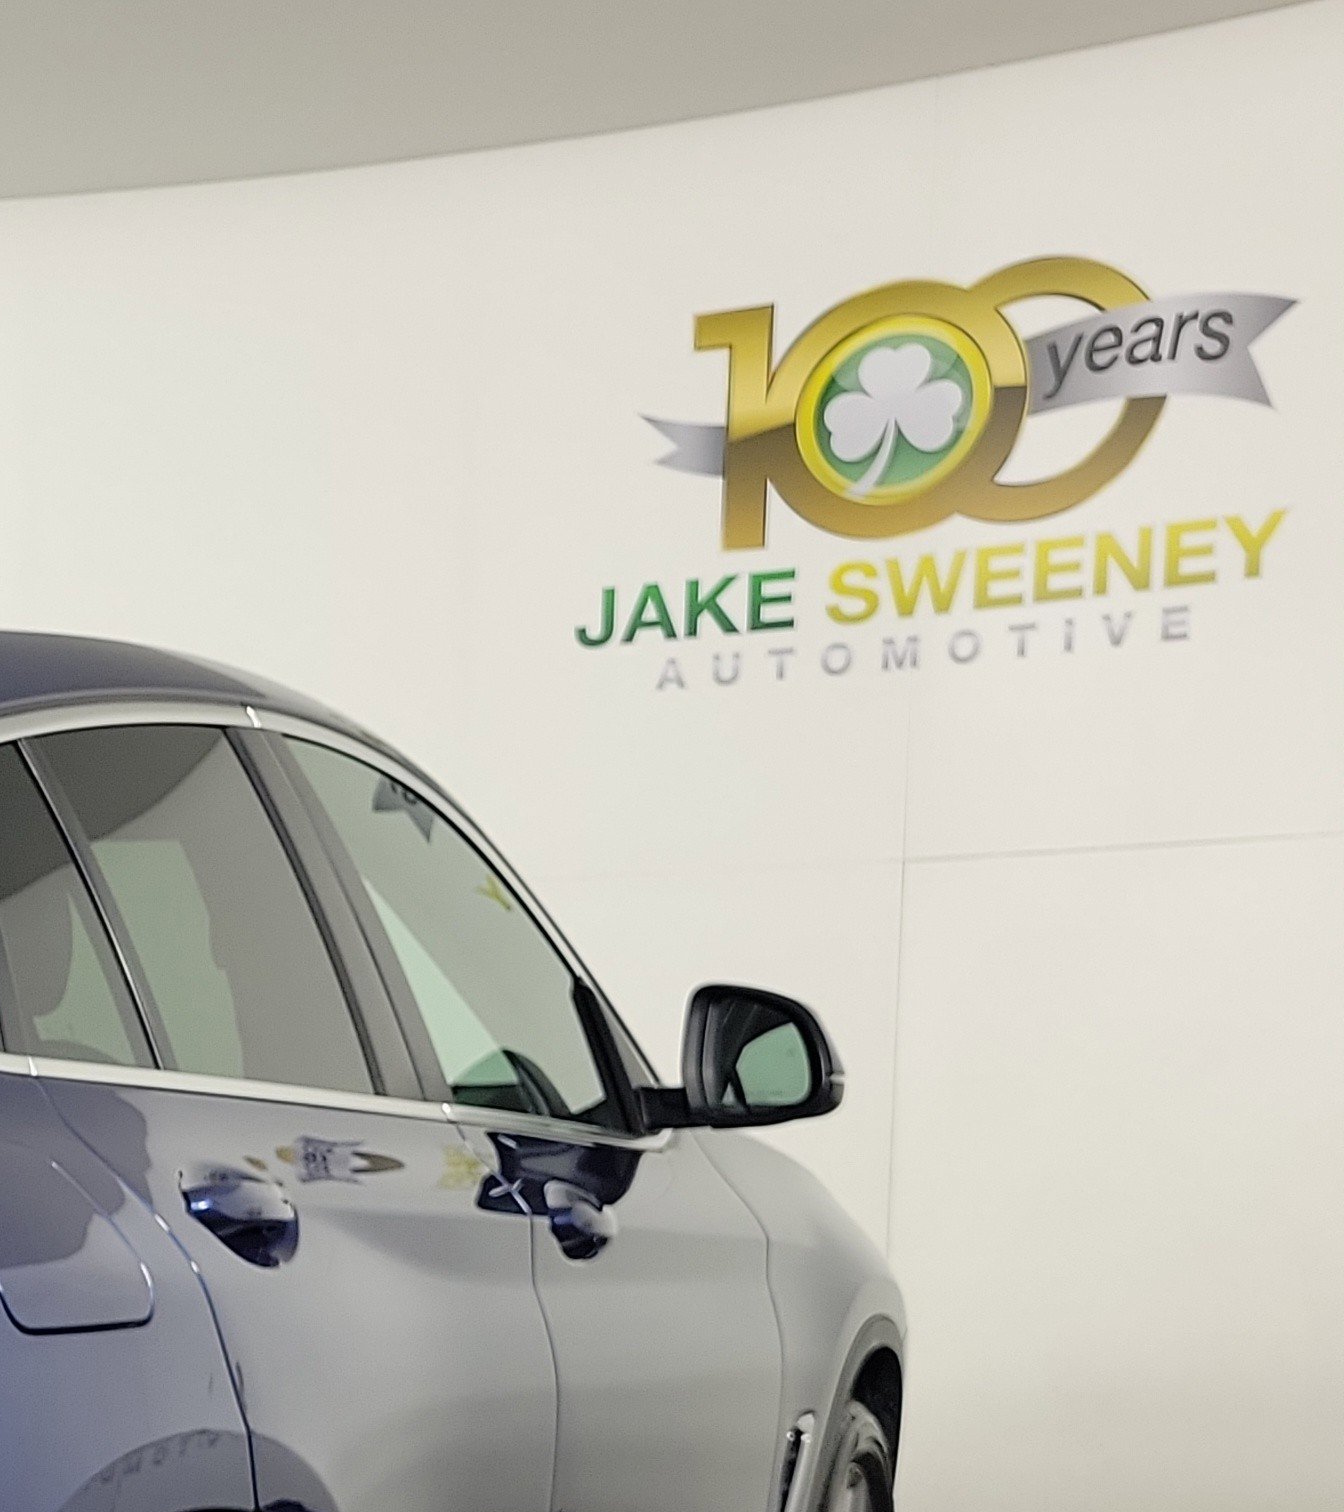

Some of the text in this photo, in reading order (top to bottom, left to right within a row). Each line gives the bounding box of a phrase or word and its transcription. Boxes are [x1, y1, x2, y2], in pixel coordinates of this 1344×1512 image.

[1046, 304, 1234, 398] years
[574, 508, 1290, 650] JAKE SWEENEY
[656, 605, 1192, 691] AUTOMOTIVE
